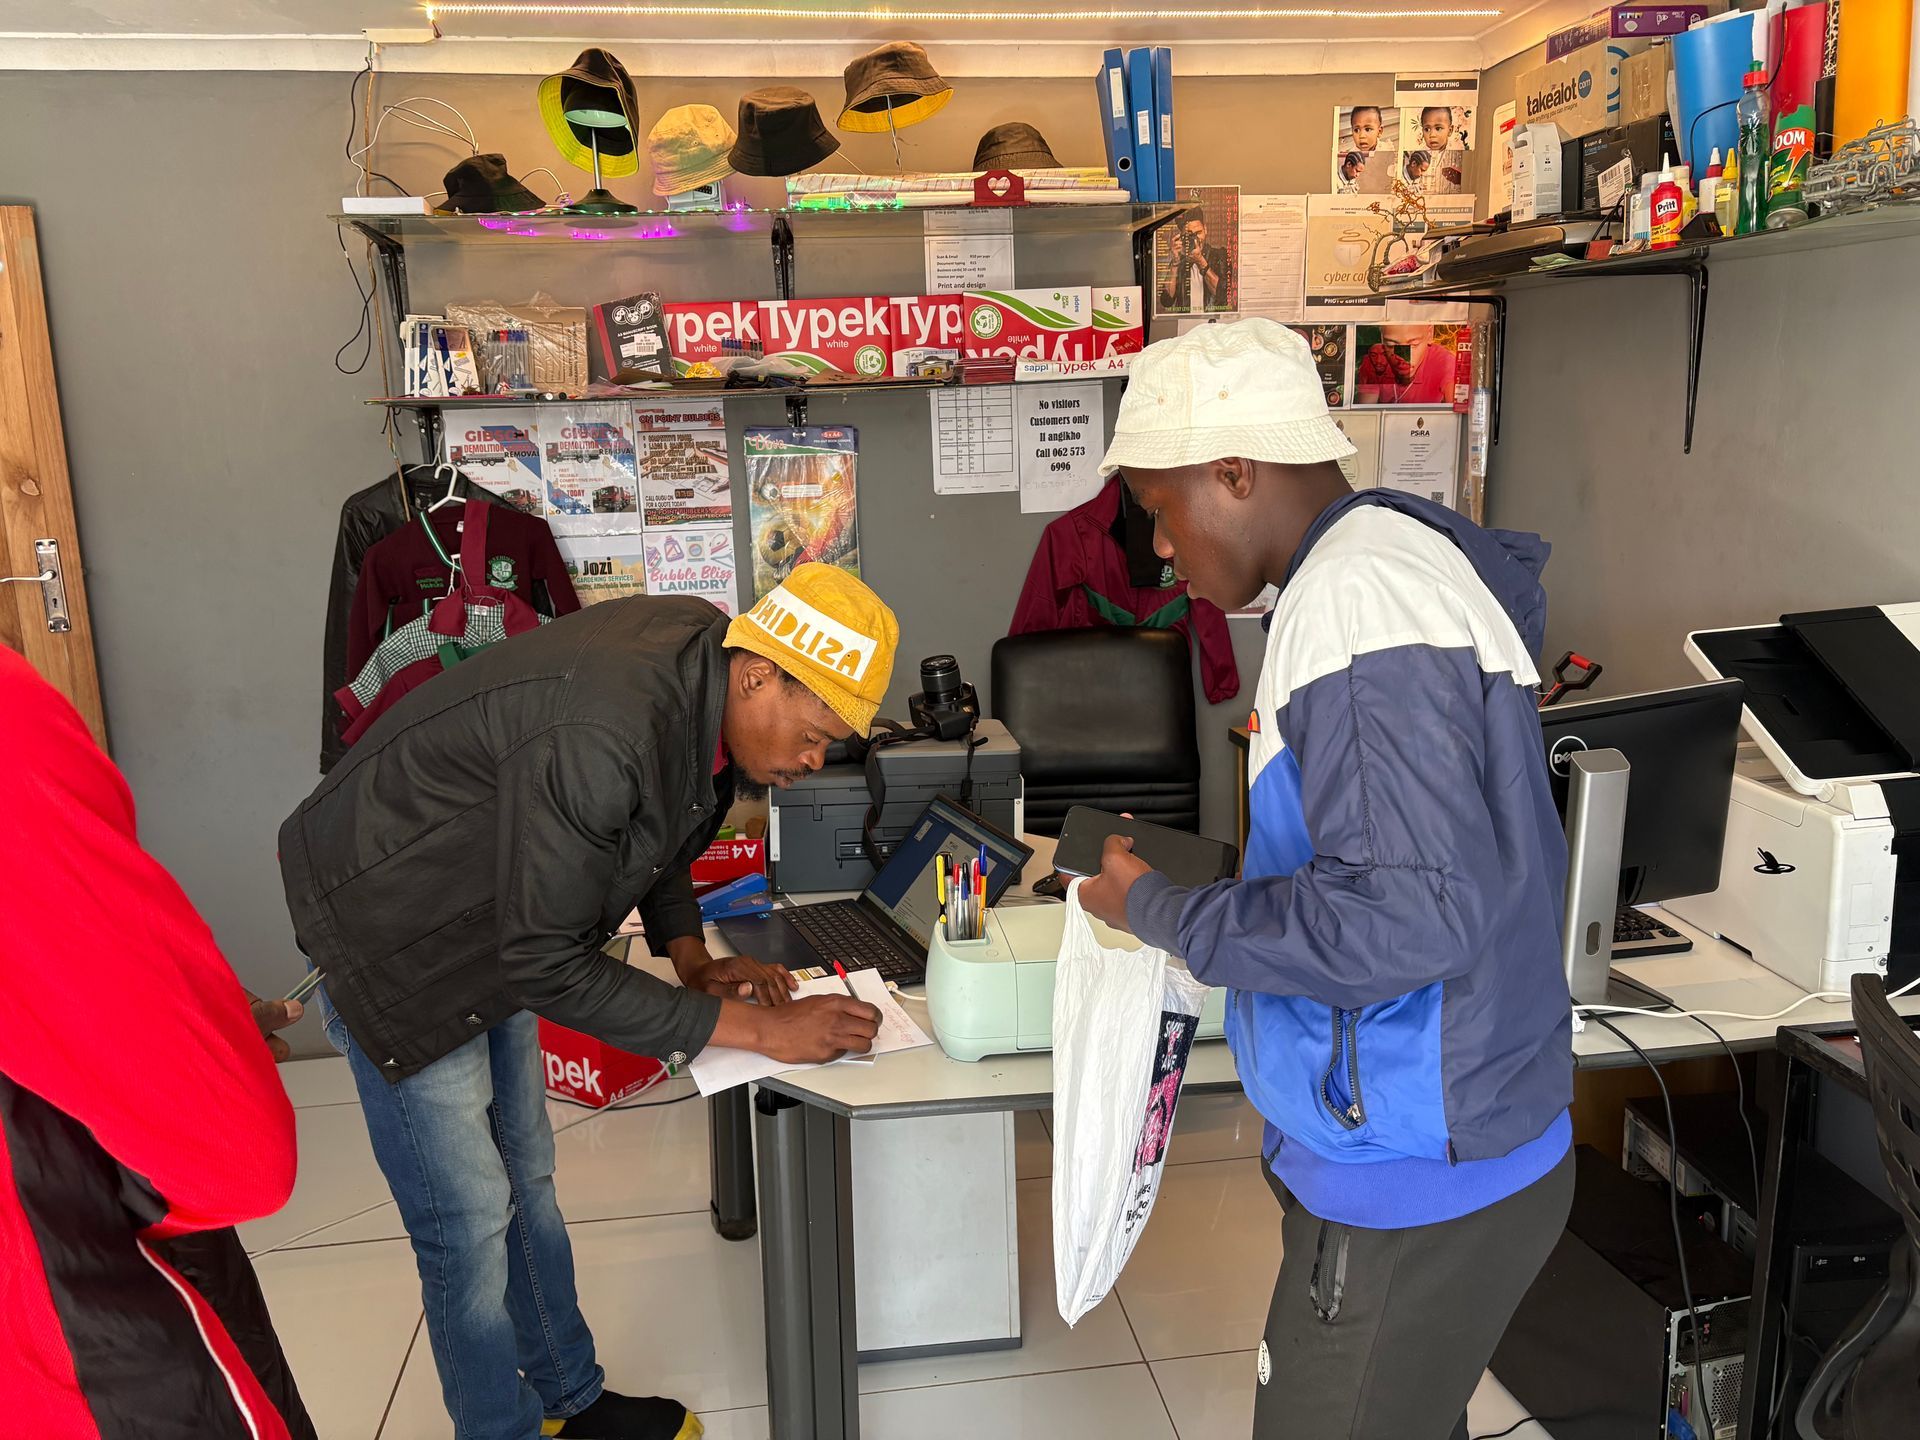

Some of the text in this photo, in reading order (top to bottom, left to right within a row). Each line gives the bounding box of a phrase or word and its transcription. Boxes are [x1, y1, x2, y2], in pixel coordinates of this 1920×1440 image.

[1526, 78, 1591, 116] takealot com
[1536, 113, 1550, 124] anything
[1564, 102, 1578, 113] imagine
[1775, 131, 1805, 150] OOM
[1657, 200, 1676, 212] Pritt
[1324, 270, 1368, 284] cyber caf
[966, 281, 986, 290] design
[666, 302, 760, 353] pek
[758, 298, 890, 350] Typek
[890, 296, 964, 346] Typ
[694, 344, 718, 353] white
[826, 339, 849, 348] white
[1024, 359, 1124, 374] sappi Typek A4
[1039, 399, 1080, 410] No visitors
[639, 415, 653, 423] ON
[655, 414, 681, 423] POINT
[1030, 414, 1090, 426] Customers only
[1048, 431, 1081, 442] angikho
[464, 444, 504, 453] DEMOLITION
[1036, 447, 1085, 458] Call 062 573
[1050, 462, 1071, 471] 6996
[582, 557, 612, 576] Jozi
[577, 576, 606, 584] GARDENING
[651, 565, 734, 582] Bubble Bliss
[659, 579, 729, 592] LAUNDRY
[732, 844, 757, 859] A4
[541, 1050, 604, 1098] pek
[610, 1088, 624, 1103] A4
